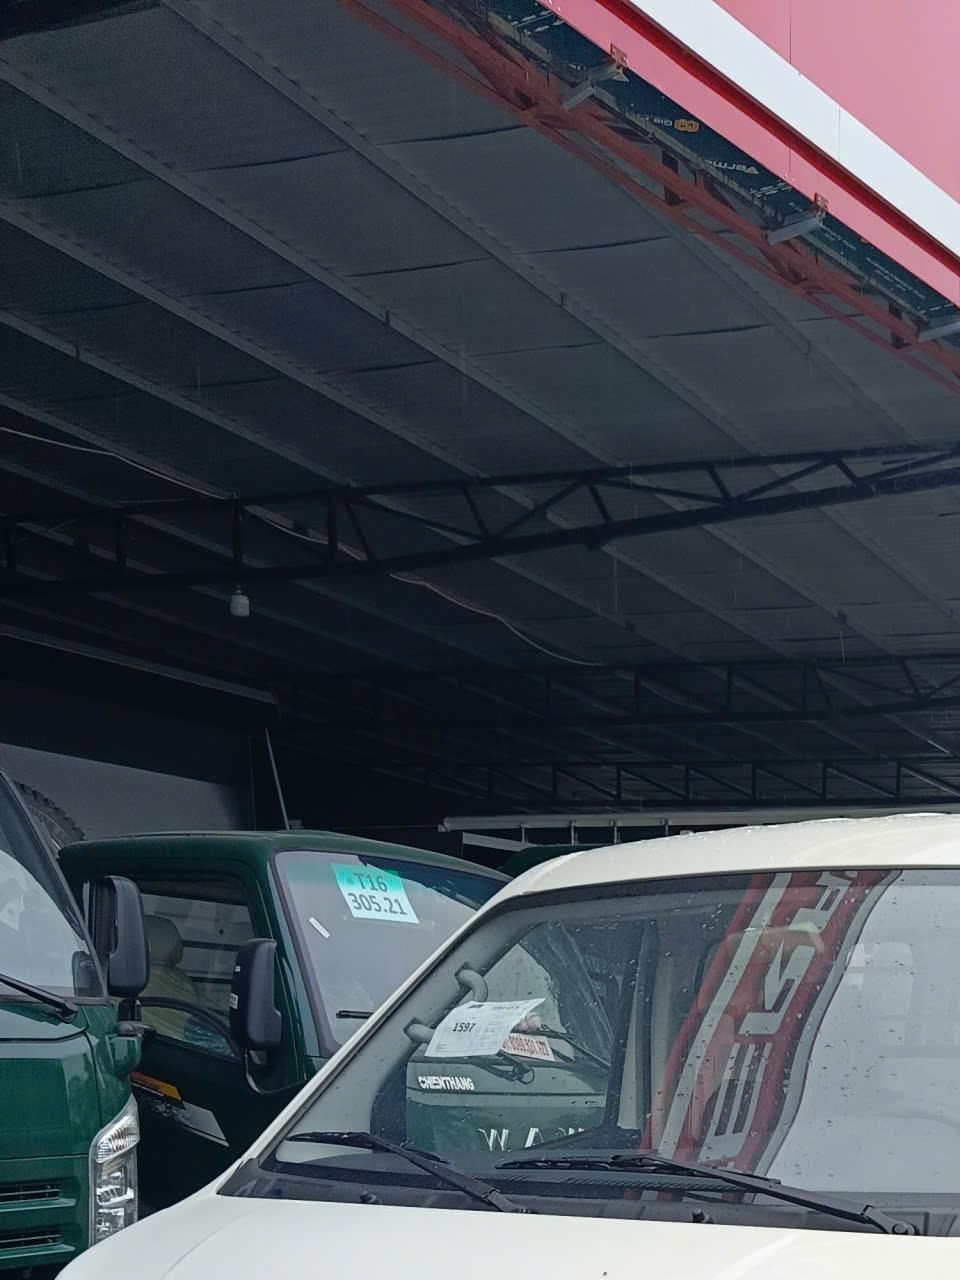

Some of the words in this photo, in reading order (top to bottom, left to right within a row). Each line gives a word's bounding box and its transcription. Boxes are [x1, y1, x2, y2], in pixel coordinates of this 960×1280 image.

[353, 872, 388, 893] T16
[347, 892, 408, 916] 305.21
[477, 1127, 584, 1152] WA
